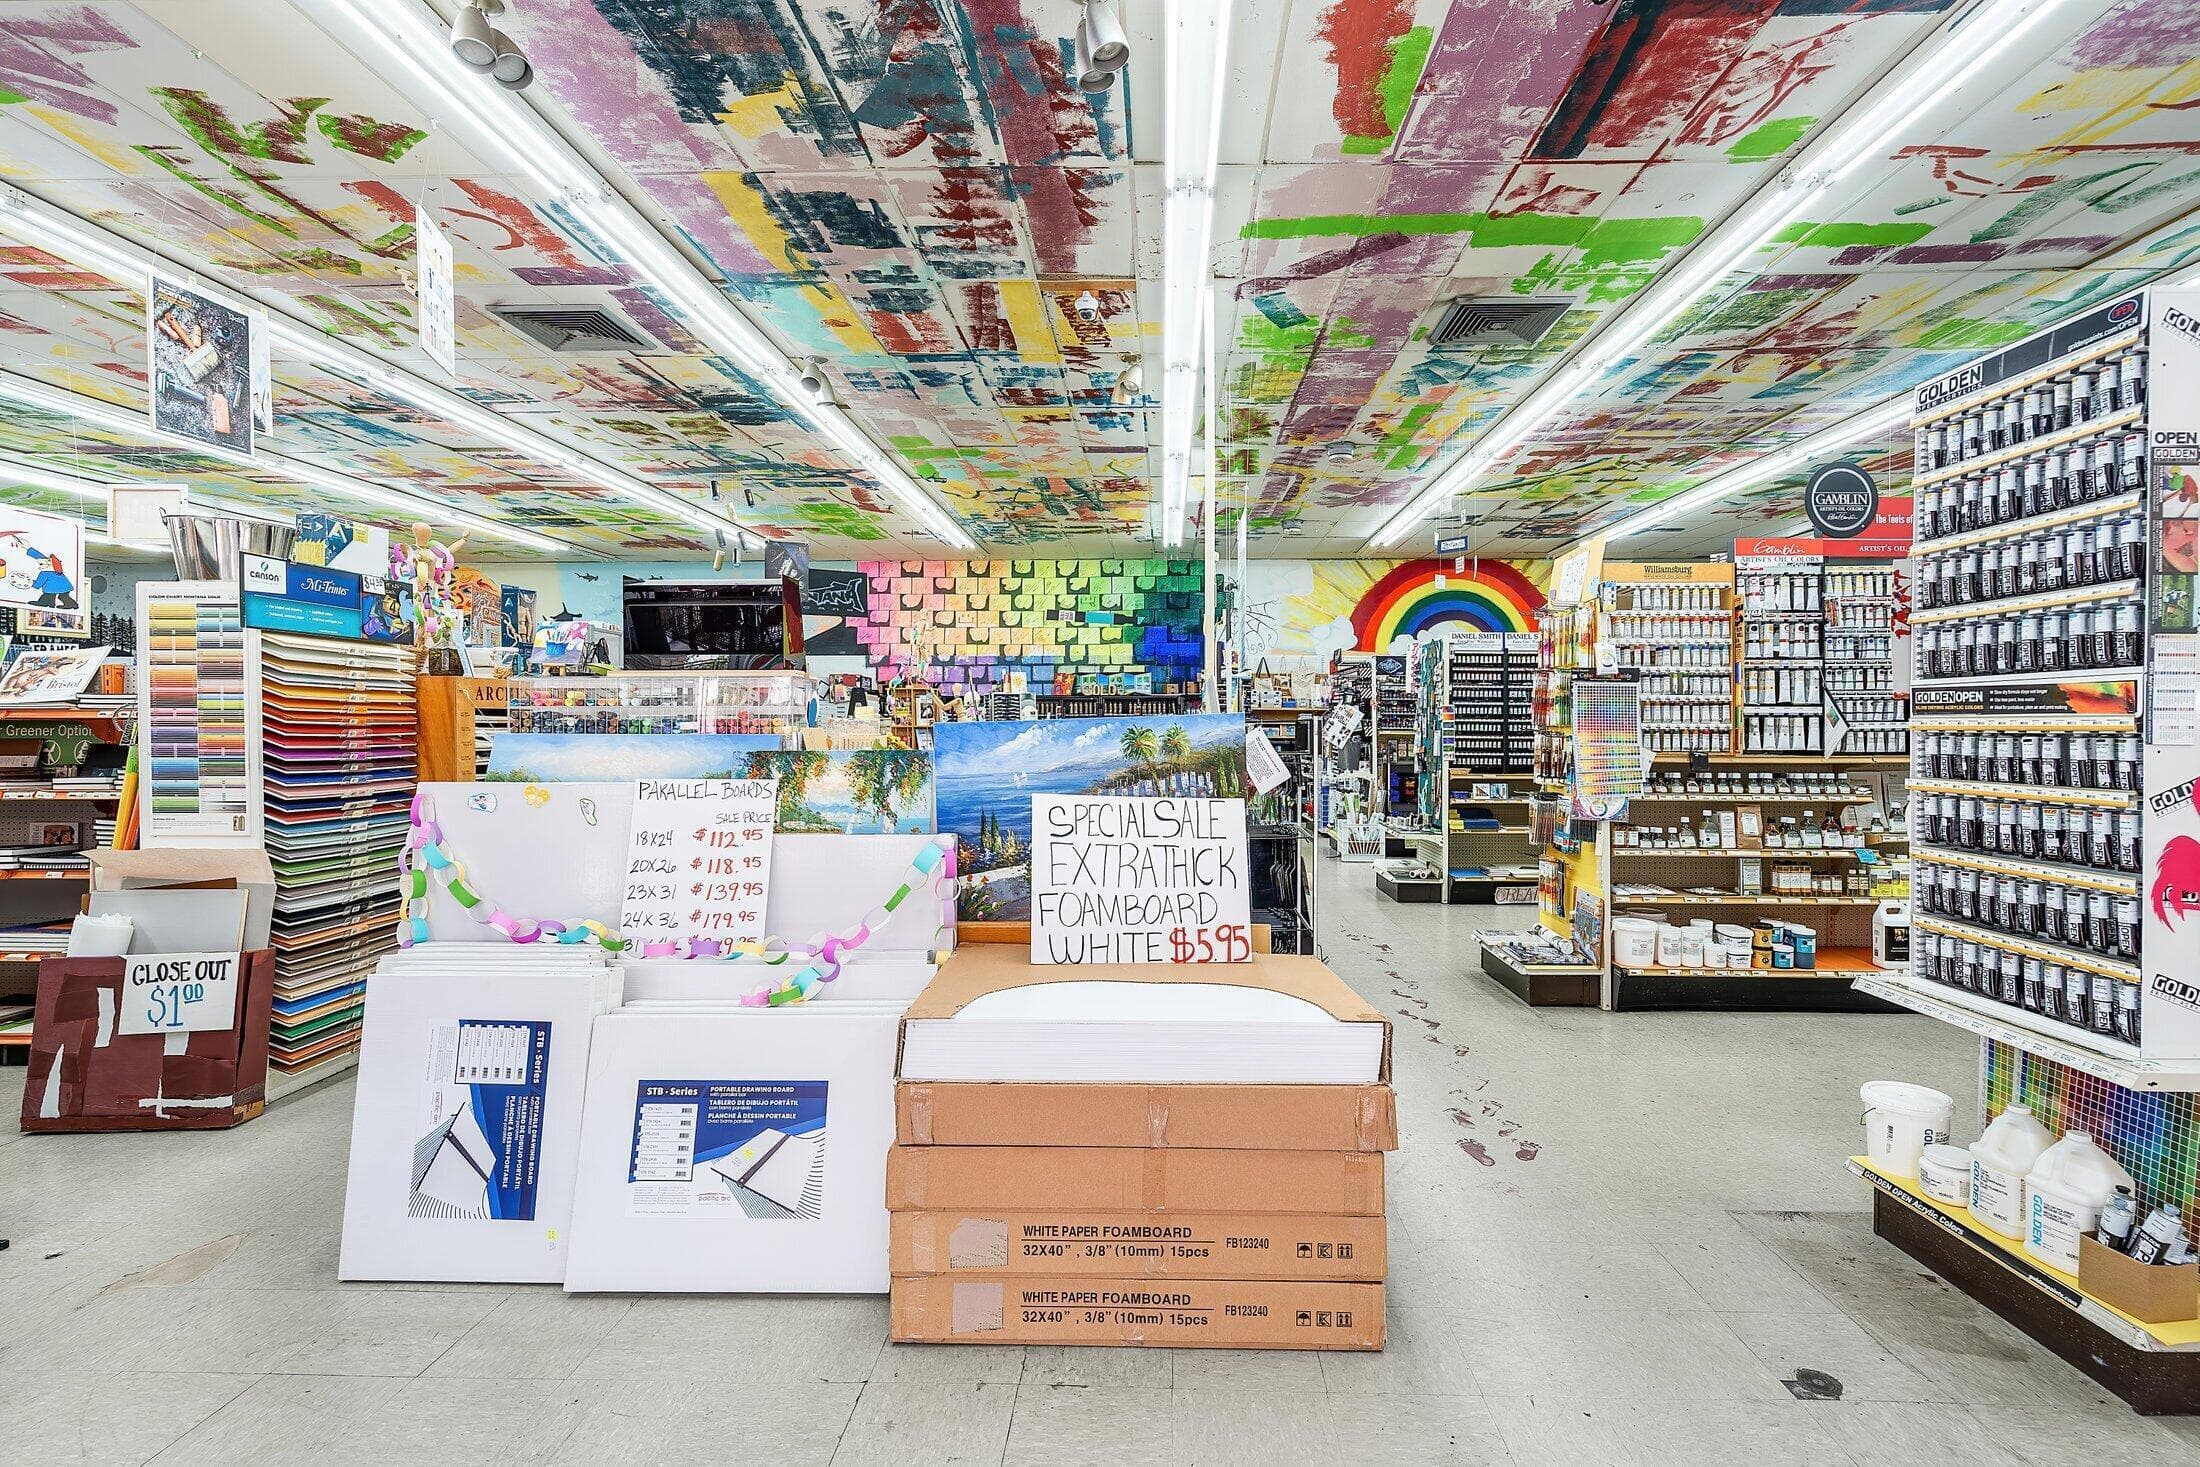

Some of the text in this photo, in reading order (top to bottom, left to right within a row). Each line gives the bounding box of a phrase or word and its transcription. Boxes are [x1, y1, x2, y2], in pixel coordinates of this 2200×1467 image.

[2112, 302, 2134, 318] OPEN
[2165, 308, 2200, 341] GOL
[1918, 365, 1981, 405] GOLDEN
[2155, 432, 2197, 445] OPEN
[2155, 448, 2196, 458] GOLDEN
[1815, 493, 1868, 505] GAMBLIN
[1876, 514, 1888, 524] The
[1753, 540, 1805, 555] Gamblin
[1644, 565, 1692, 575] Williamsburg
[300, 577, 350, 597] Mi-Teintes
[1451, 632, 1501, 640] DANIEL SMITH
[1507, 632, 1531, 640] DANIEL
[2022, 641, 2030, 667] OPEN
[47, 678, 83, 690] Bristol
[6, 724, 55, 737] Greener
[2071, 763, 2080, 788] OPEN
[638, 780, 773, 801] PARALLEL BOARDS
[715, 811, 773, 825] SALE PRICE
[635, 829, 674, 848] 18X24
[1986, 825, 1996, 847] OPEN
[2072, 833, 2081, 861] OPEN
[629, 857, 677, 875] 20X26
[1038, 892, 1218, 927] FOAMBOARD
[2001, 903, 2009, 928] OPEN
[1048, 924, 1250, 965] WHITE $5.95
[2123, 927, 2131, 951] OPEN
[132, 959, 232, 986] CLOSE OUT
[532, 1030, 545, 1084] STB Series
[646, 1087, 698, 1096] STB Series
[1972, 1160, 1981, 1209] GOLDEN
[1864, 1170, 1965, 1236] GOLDEN OPEN Acrylic Colors
[2032, 1194, 2043, 1247] GOLDEN
[1023, 1225, 1192, 1238] WHITE PAPER FOAMBOARD
[1226, 1237, 1270, 1249] FB123240
[1115, 1245, 1164, 1258] (10mm)
[1171, 1246, 1210, 1259] 15pcs
[1022, 1291, 1191, 1306] WHITE PAPER FOAMBOARD
[1114, 1311, 1164, 1325] (10mm)
[1170, 1313, 1209, 1327] 15pcs
[1225, 1305, 1269, 1317] FB123240
